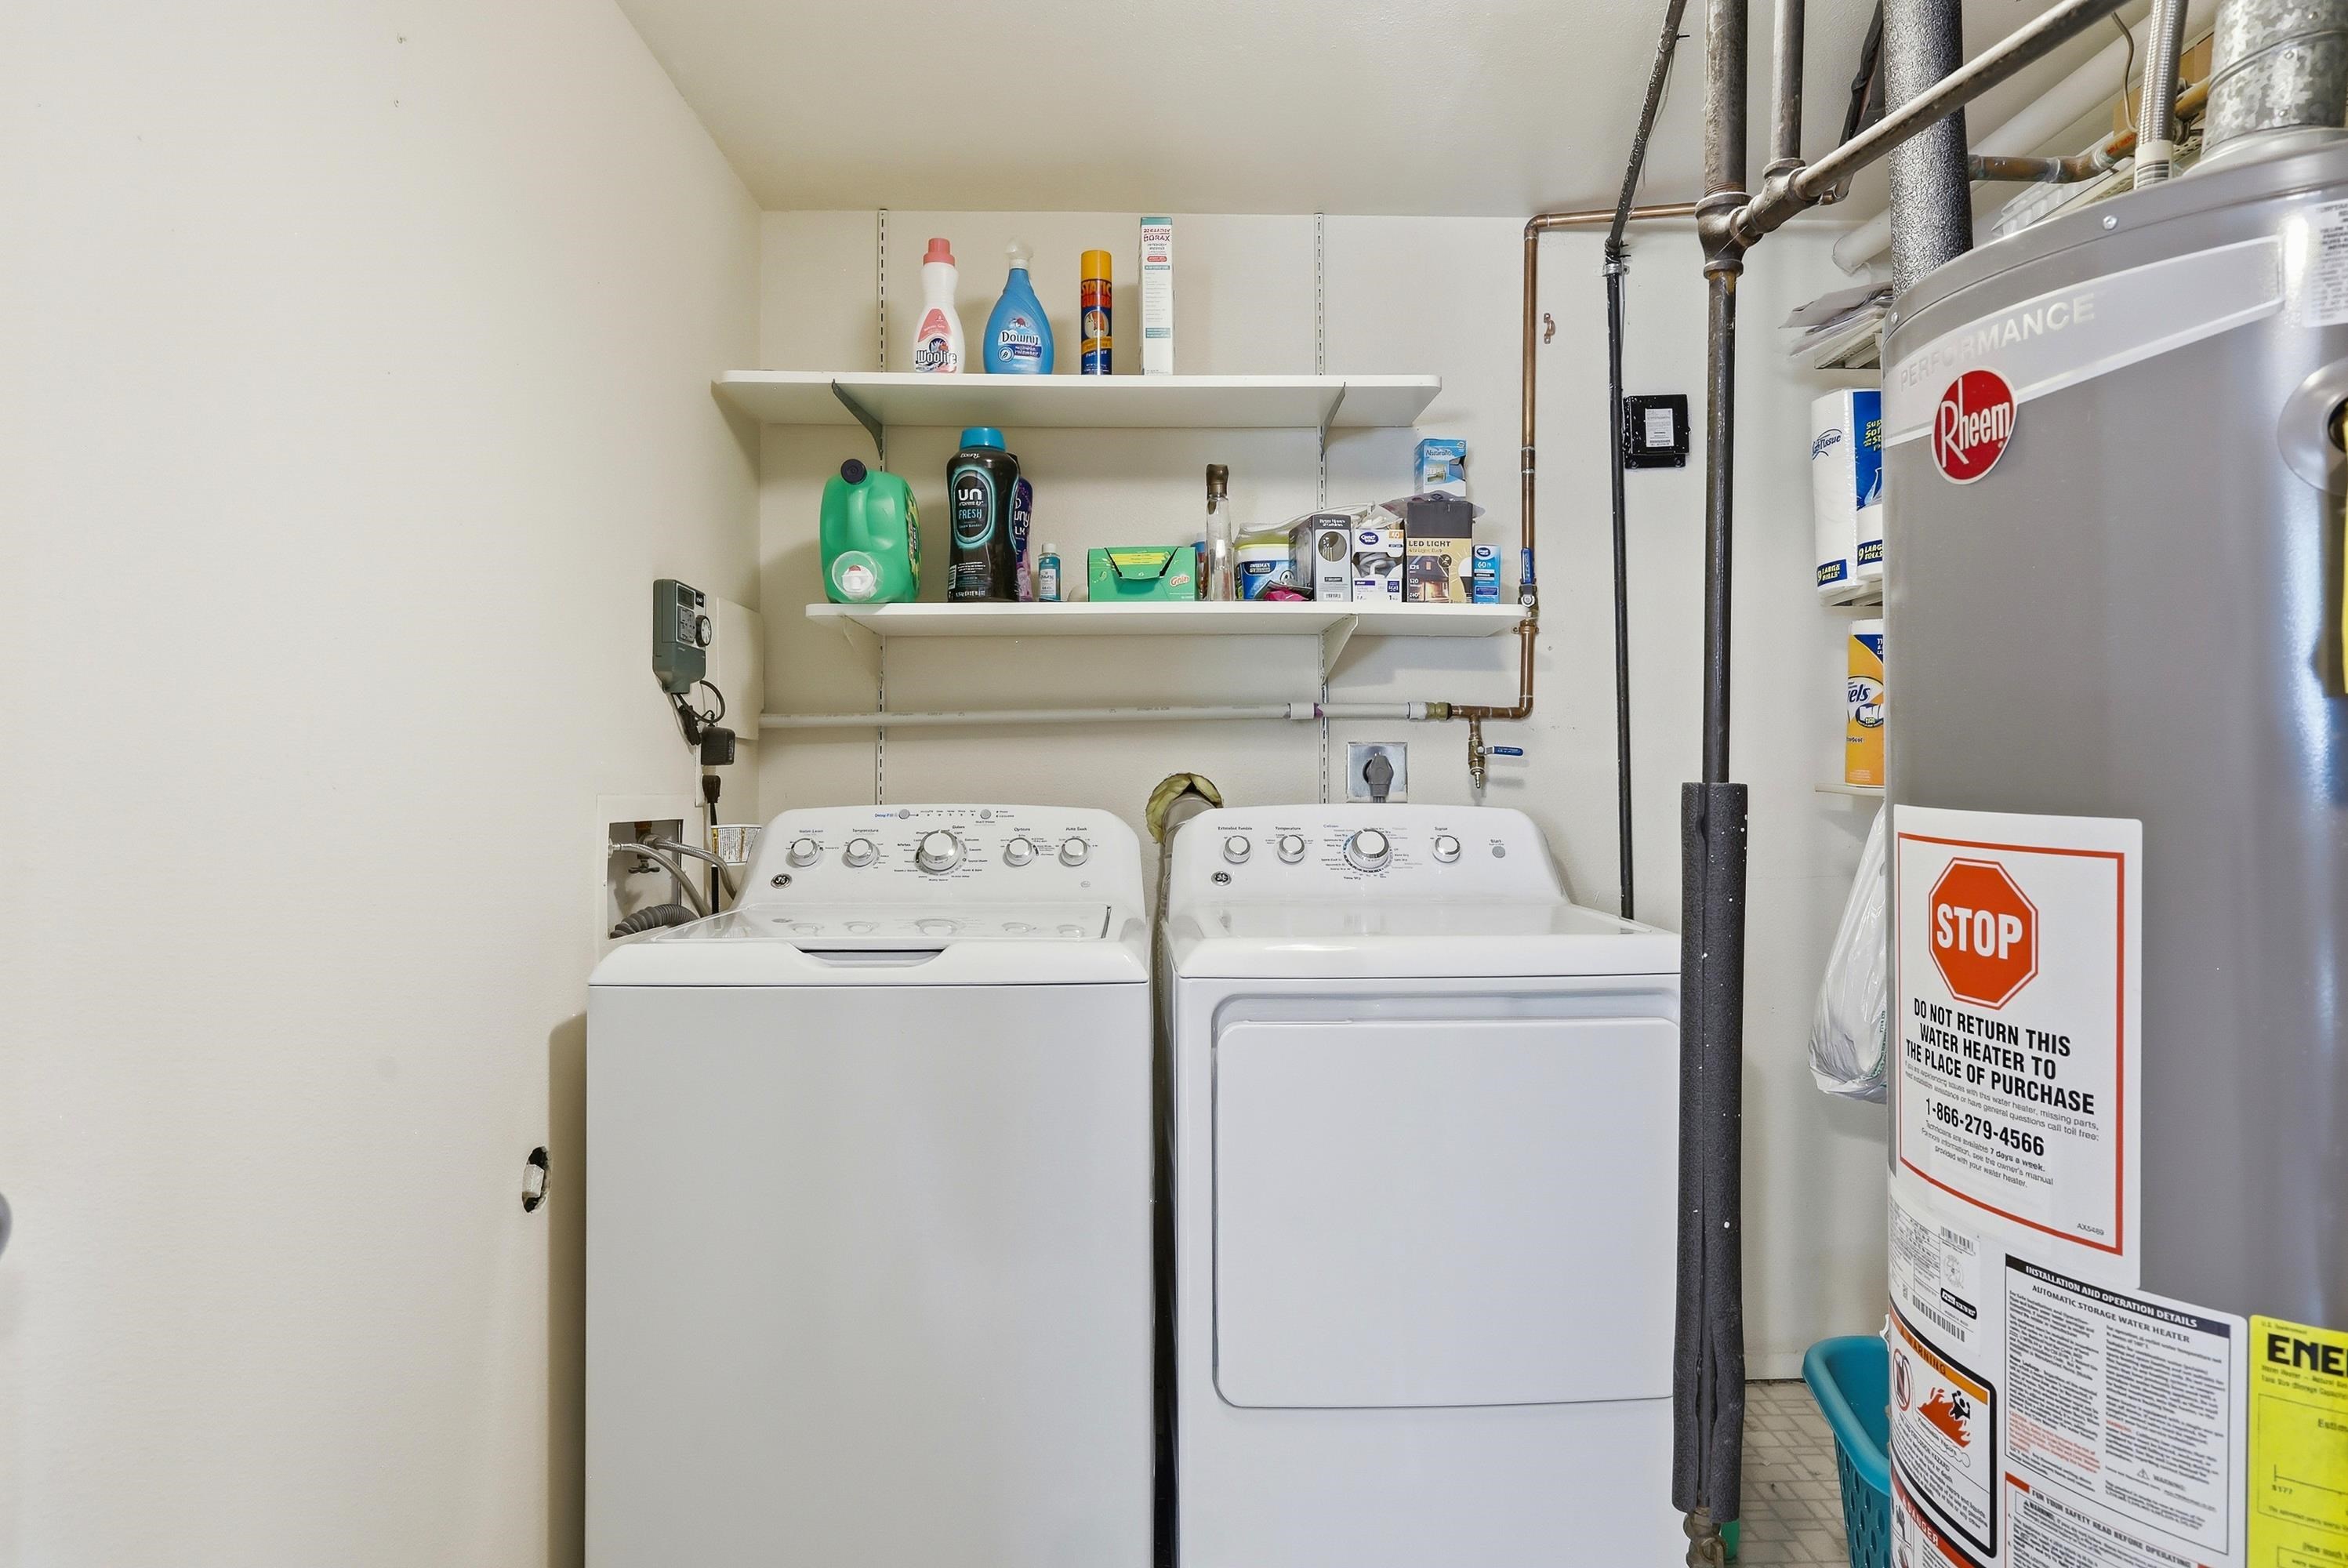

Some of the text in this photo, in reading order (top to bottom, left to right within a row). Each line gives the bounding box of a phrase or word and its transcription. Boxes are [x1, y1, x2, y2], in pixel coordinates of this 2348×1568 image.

[1082, 280, 1112, 296] STATIC
[916, 350, 957, 365] Woolite
[1002, 331, 1039, 345] Downy
[1900, 294, 2095, 391] PERFORMANCE
[1939, 378, 2012, 468] Rheem
[959, 508, 982, 520] FRESH
[1817, 564, 1841, 583] 9 LARGE
[1859, 548, 1864, 561] 9
[1171, 575, 1189, 586] Gain
[1936, 903, 2023, 960] STOP
[1914, 997, 2071, 1057] DO NOT RETURN THIS
[1920, 1023, 2056, 1080] WATER HEATER TO
[1906, 1039, 2095, 1116] THE PLACE OF PURCHASE
[1925, 1097, 2045, 1156] 1-866-279-4566
[1966, 1087, 1979, 1097] with
[1980, 1092, 1991, 1102] this
[1993, 1097, 2012, 1107] water
[2012, 1102, 2038, 1116] heater,
[2040, 1109, 2071, 1125] missing
[2074, 1118, 2099, 1131] parts,
[1968, 1097, 1982, 1109] have
[1983, 1103, 2009, 1118] general
[2009, 1112, 2045, 1127] questions
[2048, 1122, 2062, 1131] call
[2064, 1126, 2077, 1135] toll
[1957, 1156, 1968, 1165] with
[1983, 1167, 2001, 1178] water
[1972, 1152, 1983, 1162] see
[1985, 1156, 1995, 1166] the
[1997, 1161, 2023, 1176] owner's
[2025, 1171, 2054, 1186] manual
[1996, 1150, 2013, 1162] days
[2023, 1160, 2045, 1172] week.
[2025, 1265, 2197, 1328] INSTALLATION AND OPERATION DETAILS
[2032, 1285, 2190, 1343] AUTOMATIC STORAGE WATER HEATER
[2268, 1333, 2348, 1379] ENE
[2032, 1490, 2191, 1568] FOR YOUR SAFETY READ BEFORE OPERATING
